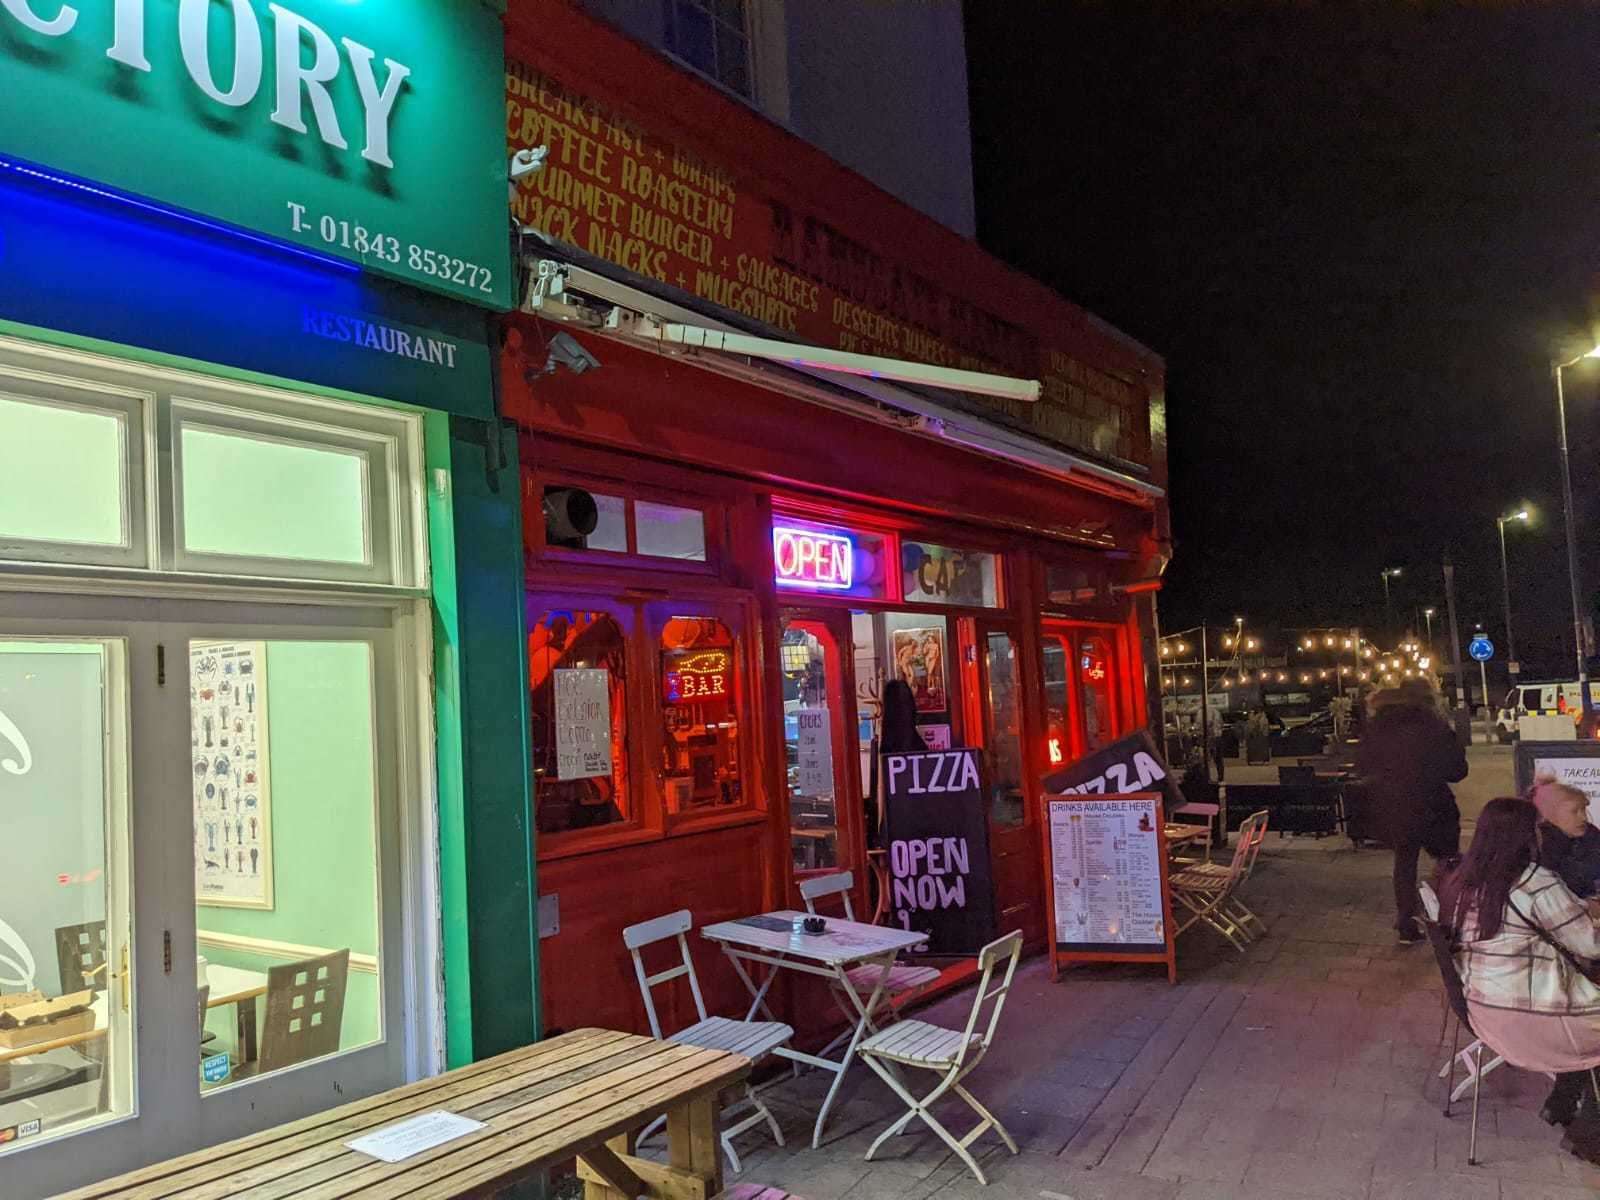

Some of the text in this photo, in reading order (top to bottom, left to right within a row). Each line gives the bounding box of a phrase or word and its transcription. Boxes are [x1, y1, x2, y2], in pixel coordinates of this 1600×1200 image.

[0, 0, 410, 169] ORY
[506, 99, 614, 185] COFFEE
[621, 154, 735, 241] ROASTERY
[507, 148, 625, 227] OURMET
[630, 201, 713, 268] BURGER
[735, 252, 820, 313] SAUSAGES
[320, 214, 401, 264] 01843
[408, 244, 493, 293] 853272
[303, 304, 457, 369] RESTAURANT
[776, 533, 849, 582] OPEN
[682, 675, 725, 698] BAR
[887, 751, 980, 795] PIZZA
[1059, 751, 1166, 795] ZZA
[1051, 800, 1153, 812] DRINKS AVAILABLE HERE
[890, 837, 970, 878] OPEN
[893, 874, 966, 911] NOW
[21, 1121, 38, 1135] VISA
